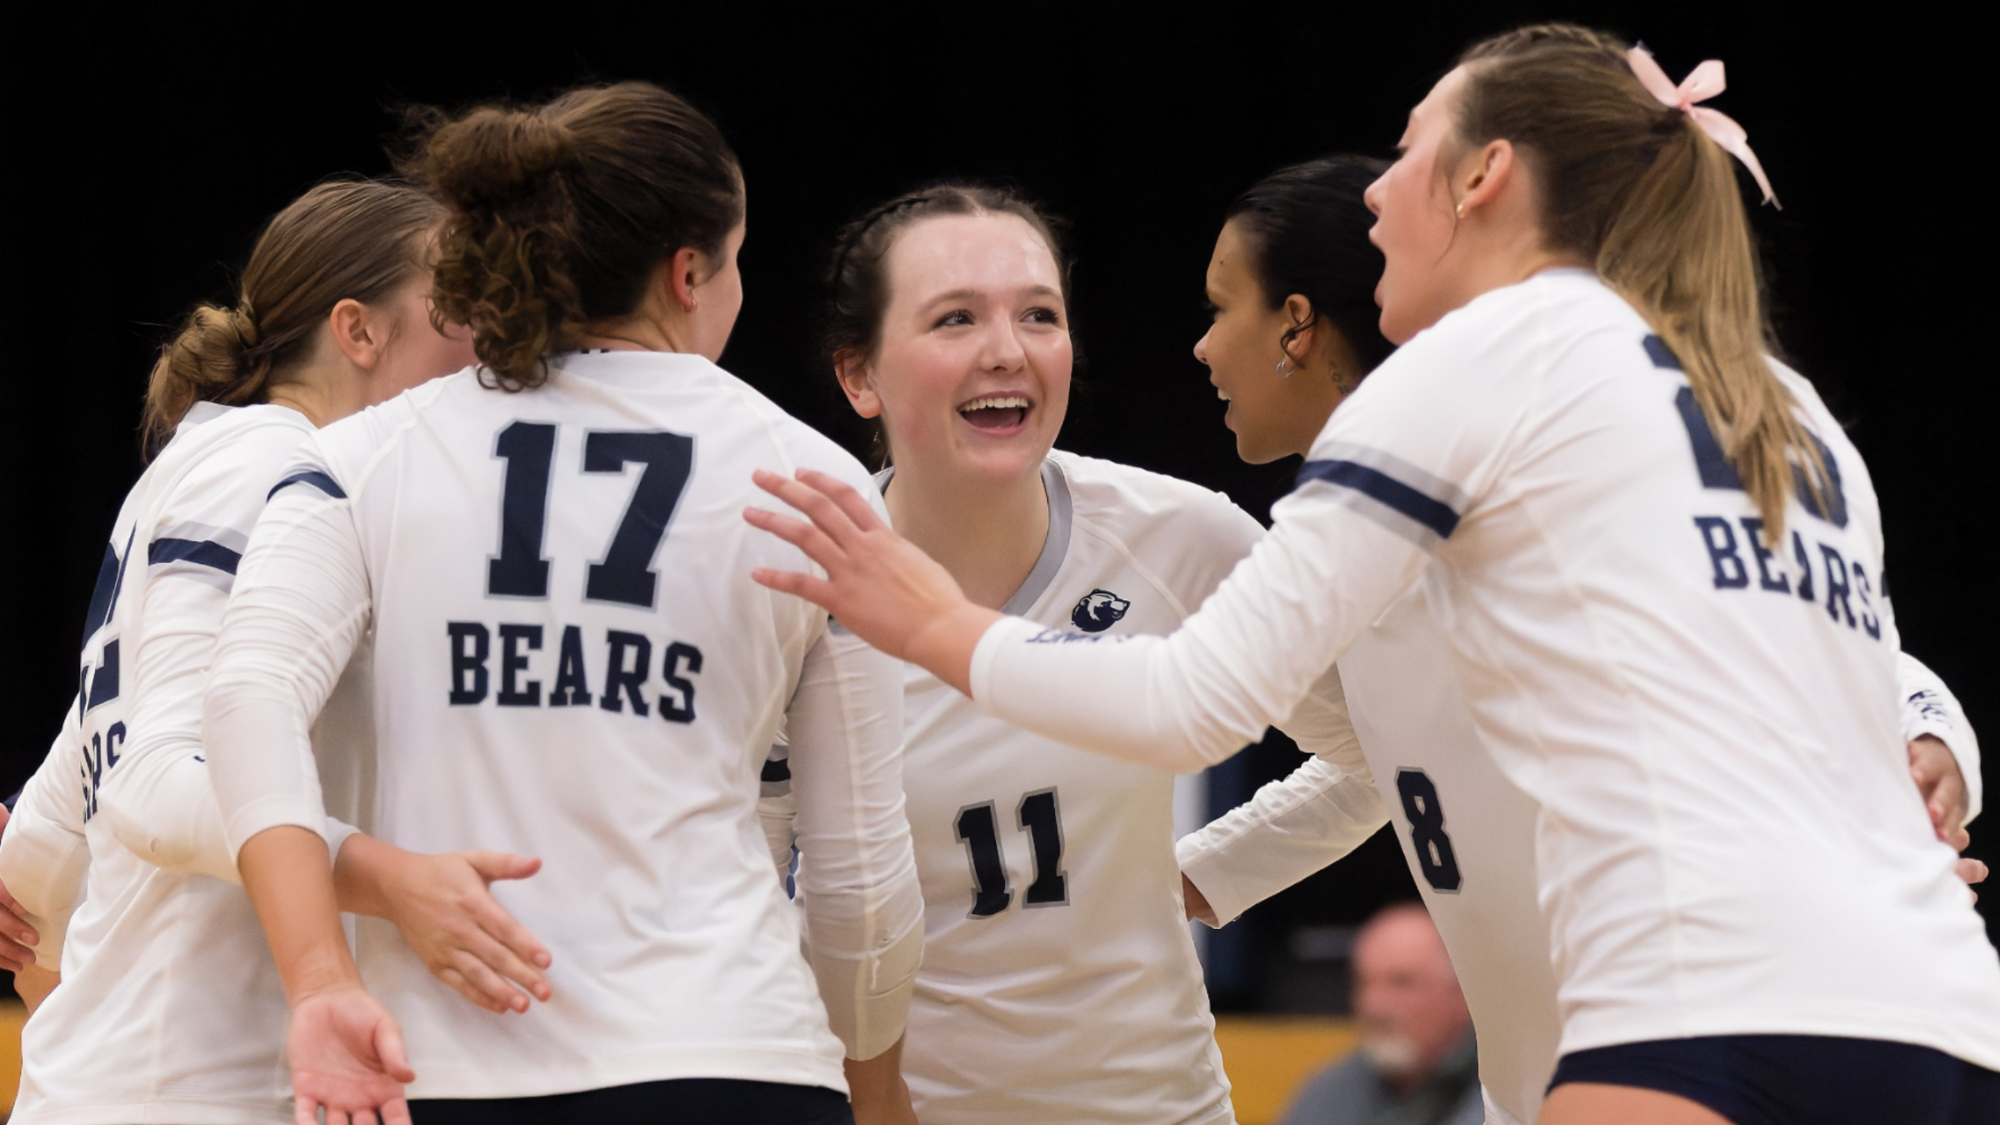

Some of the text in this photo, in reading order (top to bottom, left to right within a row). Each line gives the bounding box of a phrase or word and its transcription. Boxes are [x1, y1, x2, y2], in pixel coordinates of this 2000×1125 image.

[484, 417, 698, 613] 17
[446, 620, 704, 724] BEARS
[952, 785, 1070, 920] 11
[1394, 765, 1464, 895] 8
